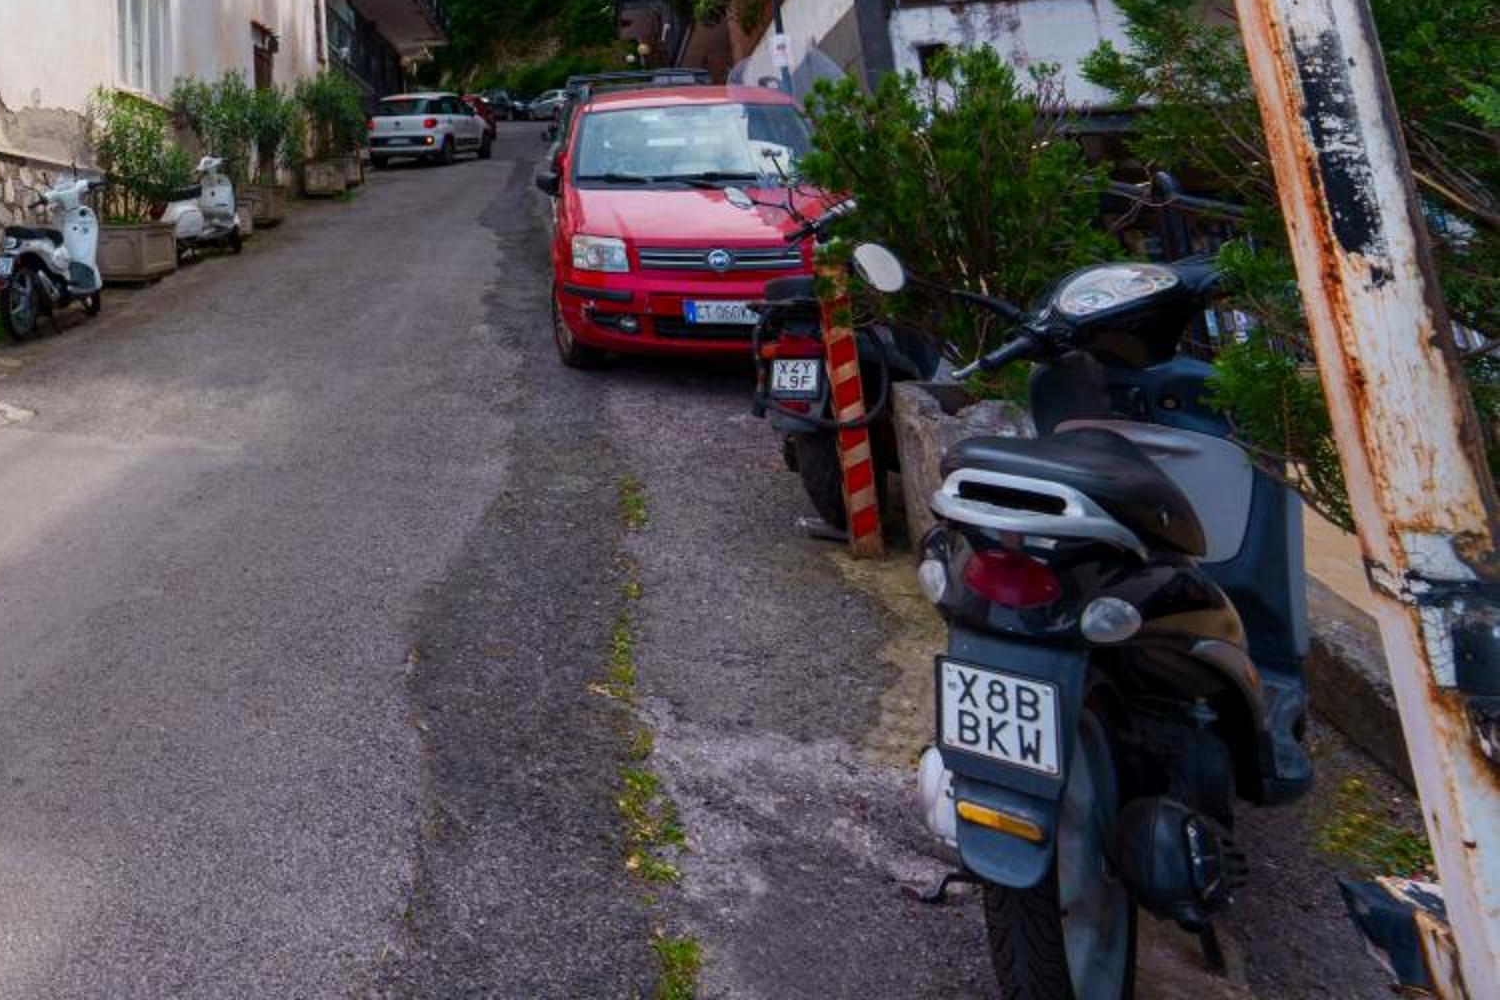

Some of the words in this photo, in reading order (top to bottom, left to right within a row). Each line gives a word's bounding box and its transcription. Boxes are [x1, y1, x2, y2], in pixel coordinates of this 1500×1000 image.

[777, 375, 813, 389] L9F
[958, 671, 1040, 722] X8B
[958, 709, 1041, 764] BKW
